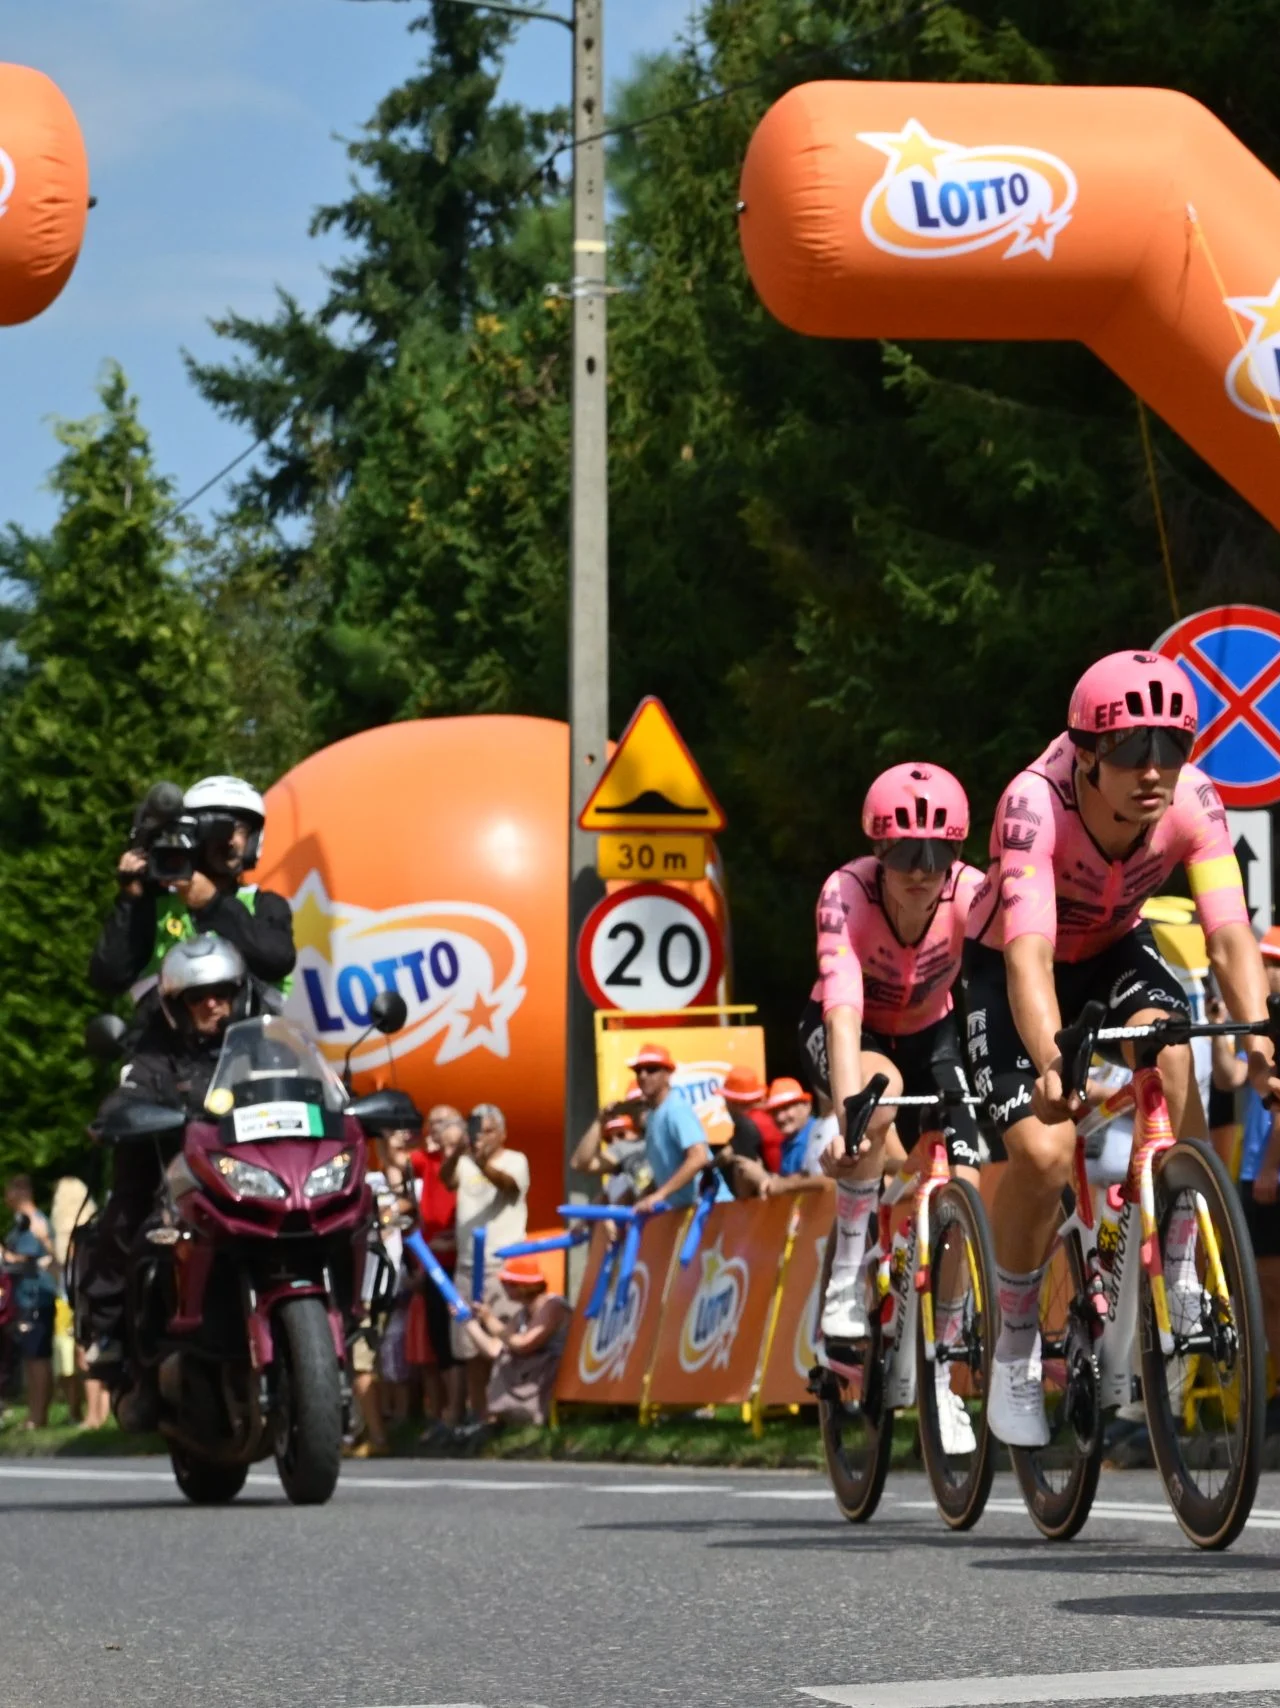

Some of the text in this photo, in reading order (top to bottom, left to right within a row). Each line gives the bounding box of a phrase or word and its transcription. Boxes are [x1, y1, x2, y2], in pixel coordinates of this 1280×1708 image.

[910, 172, 1030, 229] LOTTO
[1095, 701, 1124, 729] EF
[872, 815, 893, 836] EF
[617, 844, 688, 871] 30 m
[604, 921, 702, 989] 20
[301, 940, 460, 1035] LOTTO
[671, 1077, 720, 1105] TTO
[989, 1084, 1032, 1123] Raph
